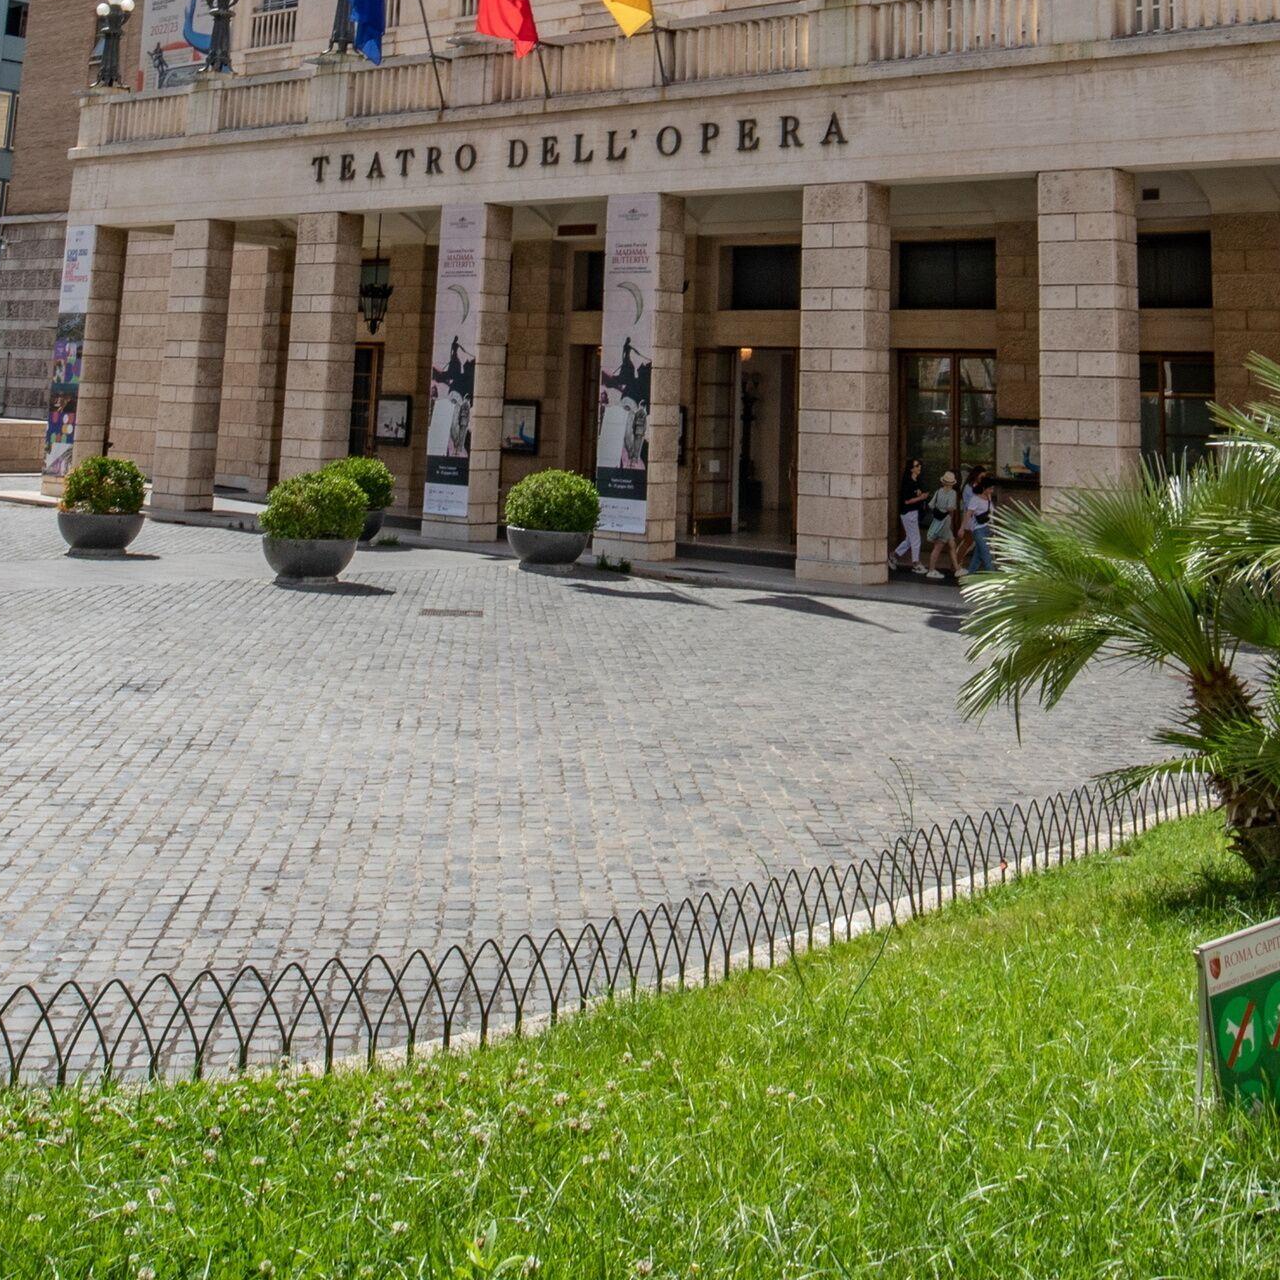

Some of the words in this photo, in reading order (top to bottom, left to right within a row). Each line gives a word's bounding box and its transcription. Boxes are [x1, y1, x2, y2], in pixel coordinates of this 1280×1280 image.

[311, 143, 478, 183] TEATRO
[507, 111, 848, 169] DELL'OPERA
[1224, 947, 1253, 969] ROMA
